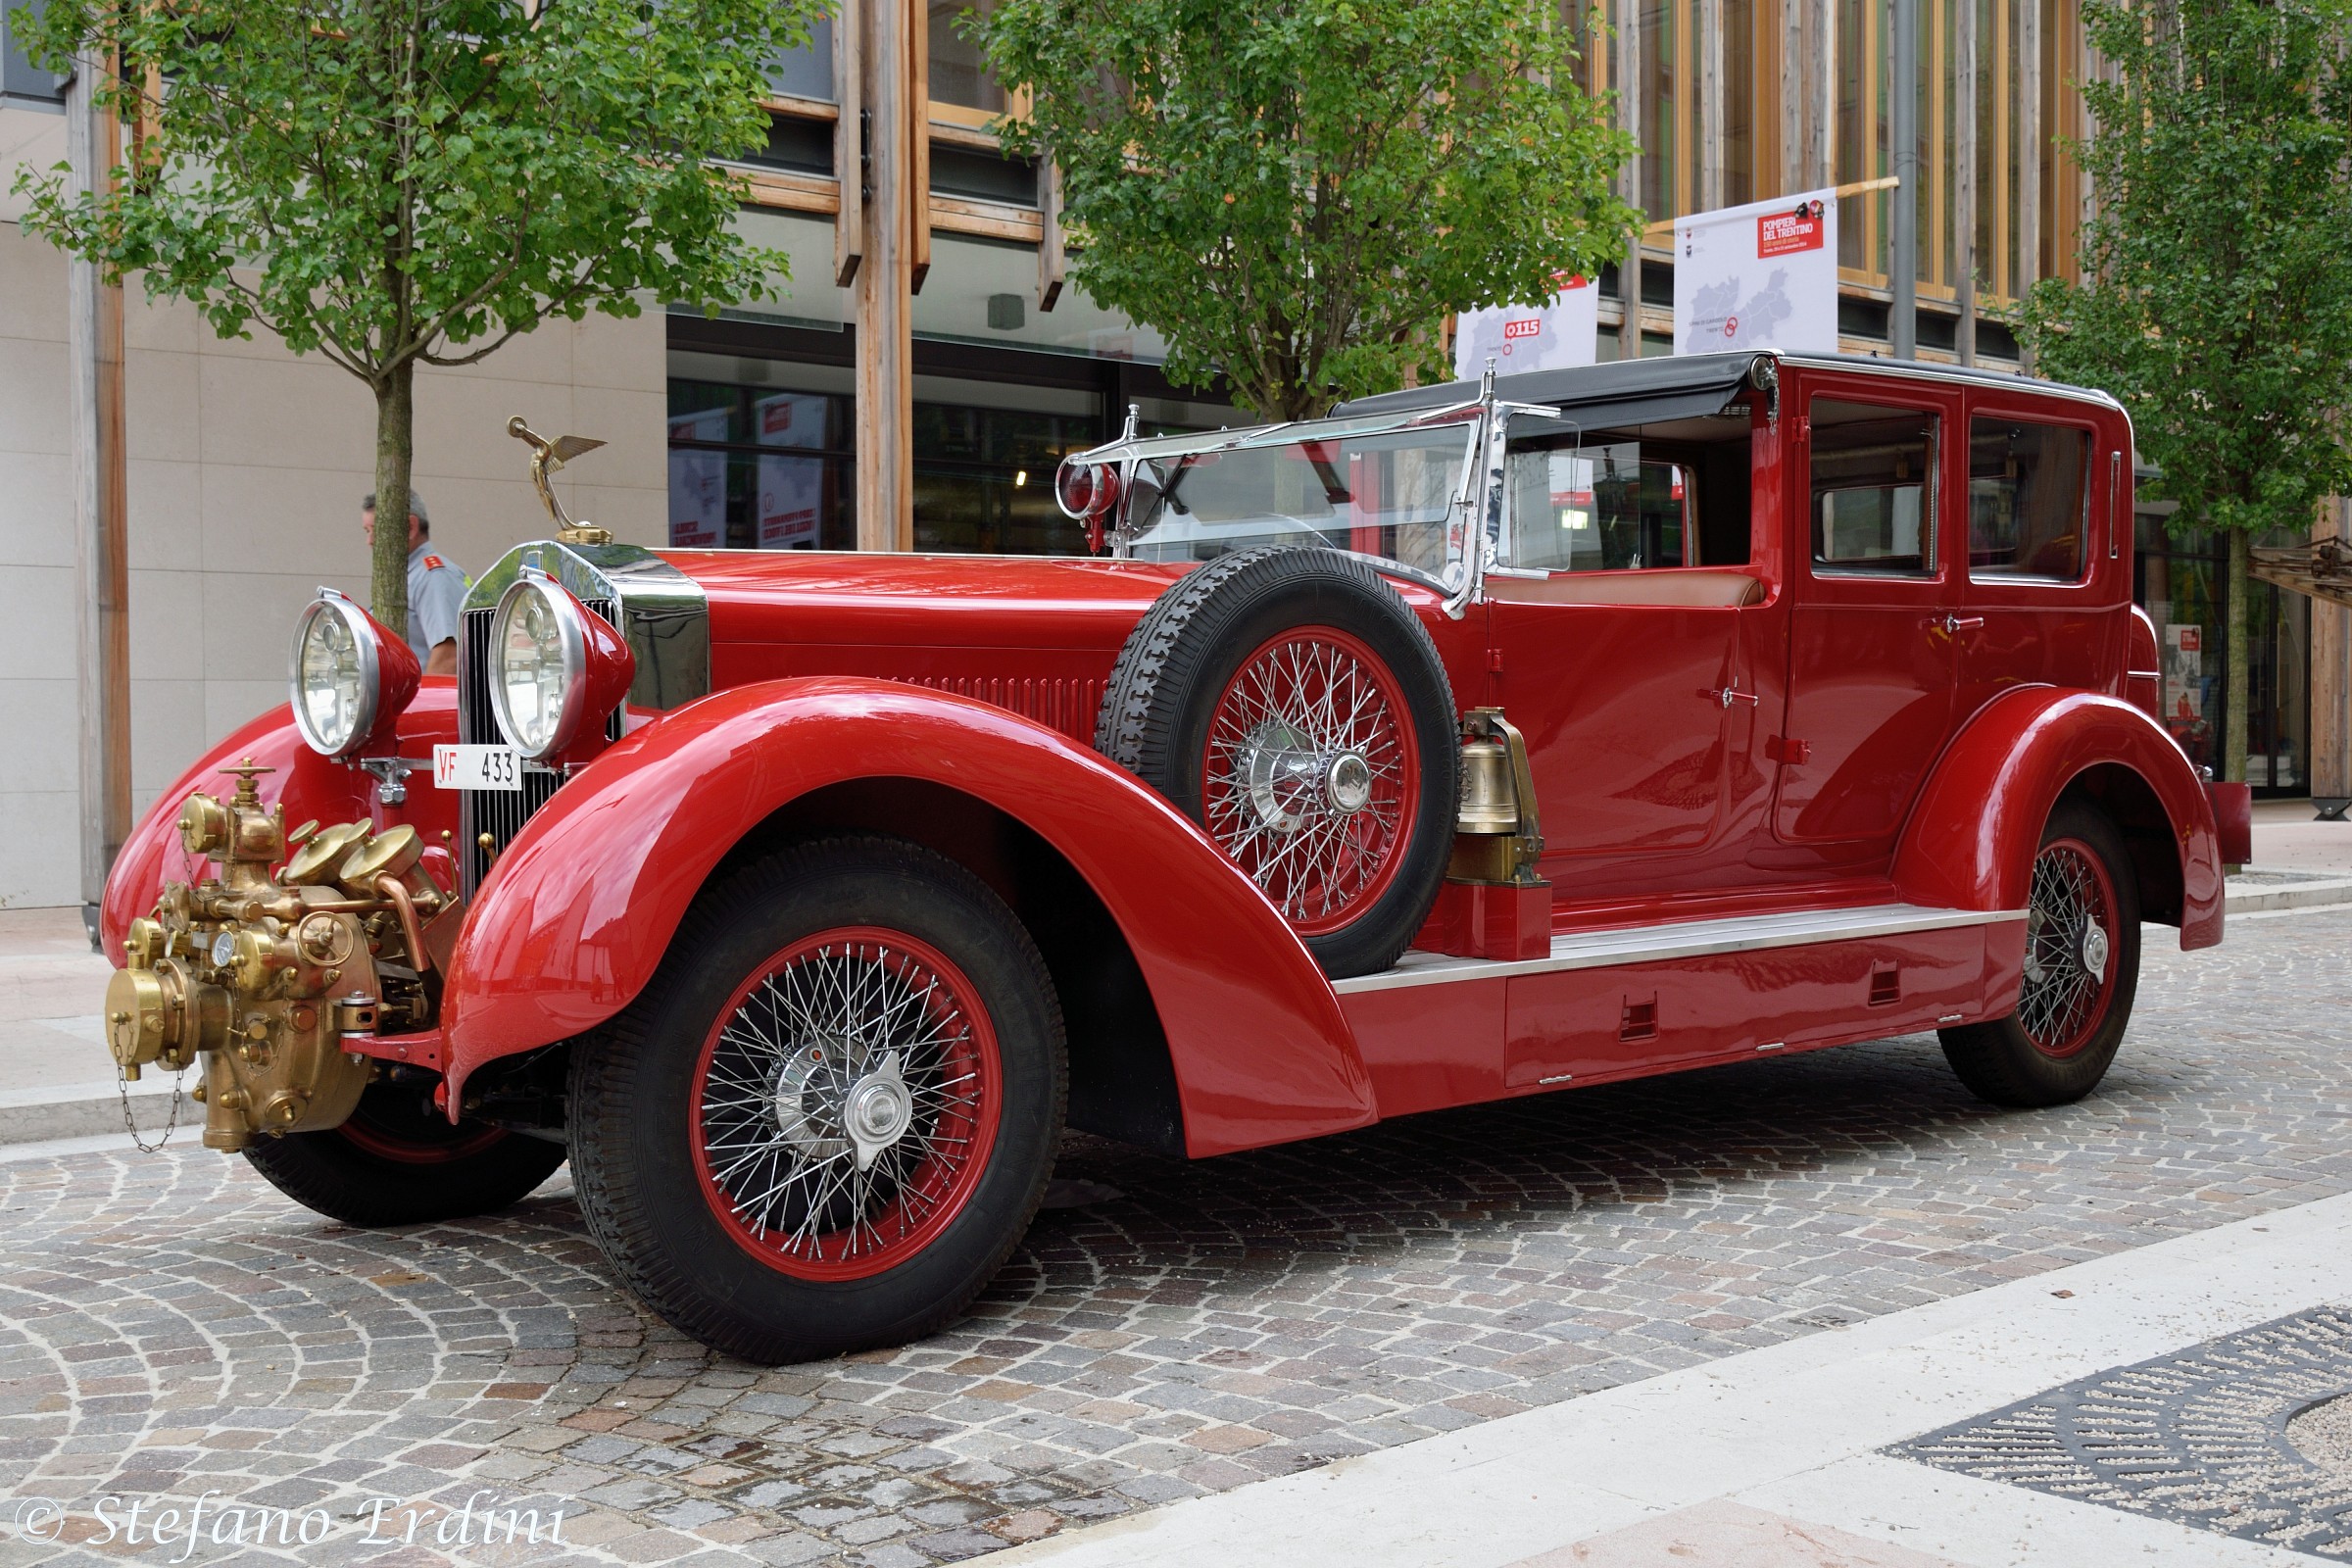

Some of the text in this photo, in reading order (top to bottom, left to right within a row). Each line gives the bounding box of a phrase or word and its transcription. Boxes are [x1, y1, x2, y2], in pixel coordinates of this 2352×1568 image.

[1763, 217, 1796, 231] POMPIERI
[1763, 222, 1814, 242] DEL TRENTINO
[439, 751, 514, 782] VF 433
